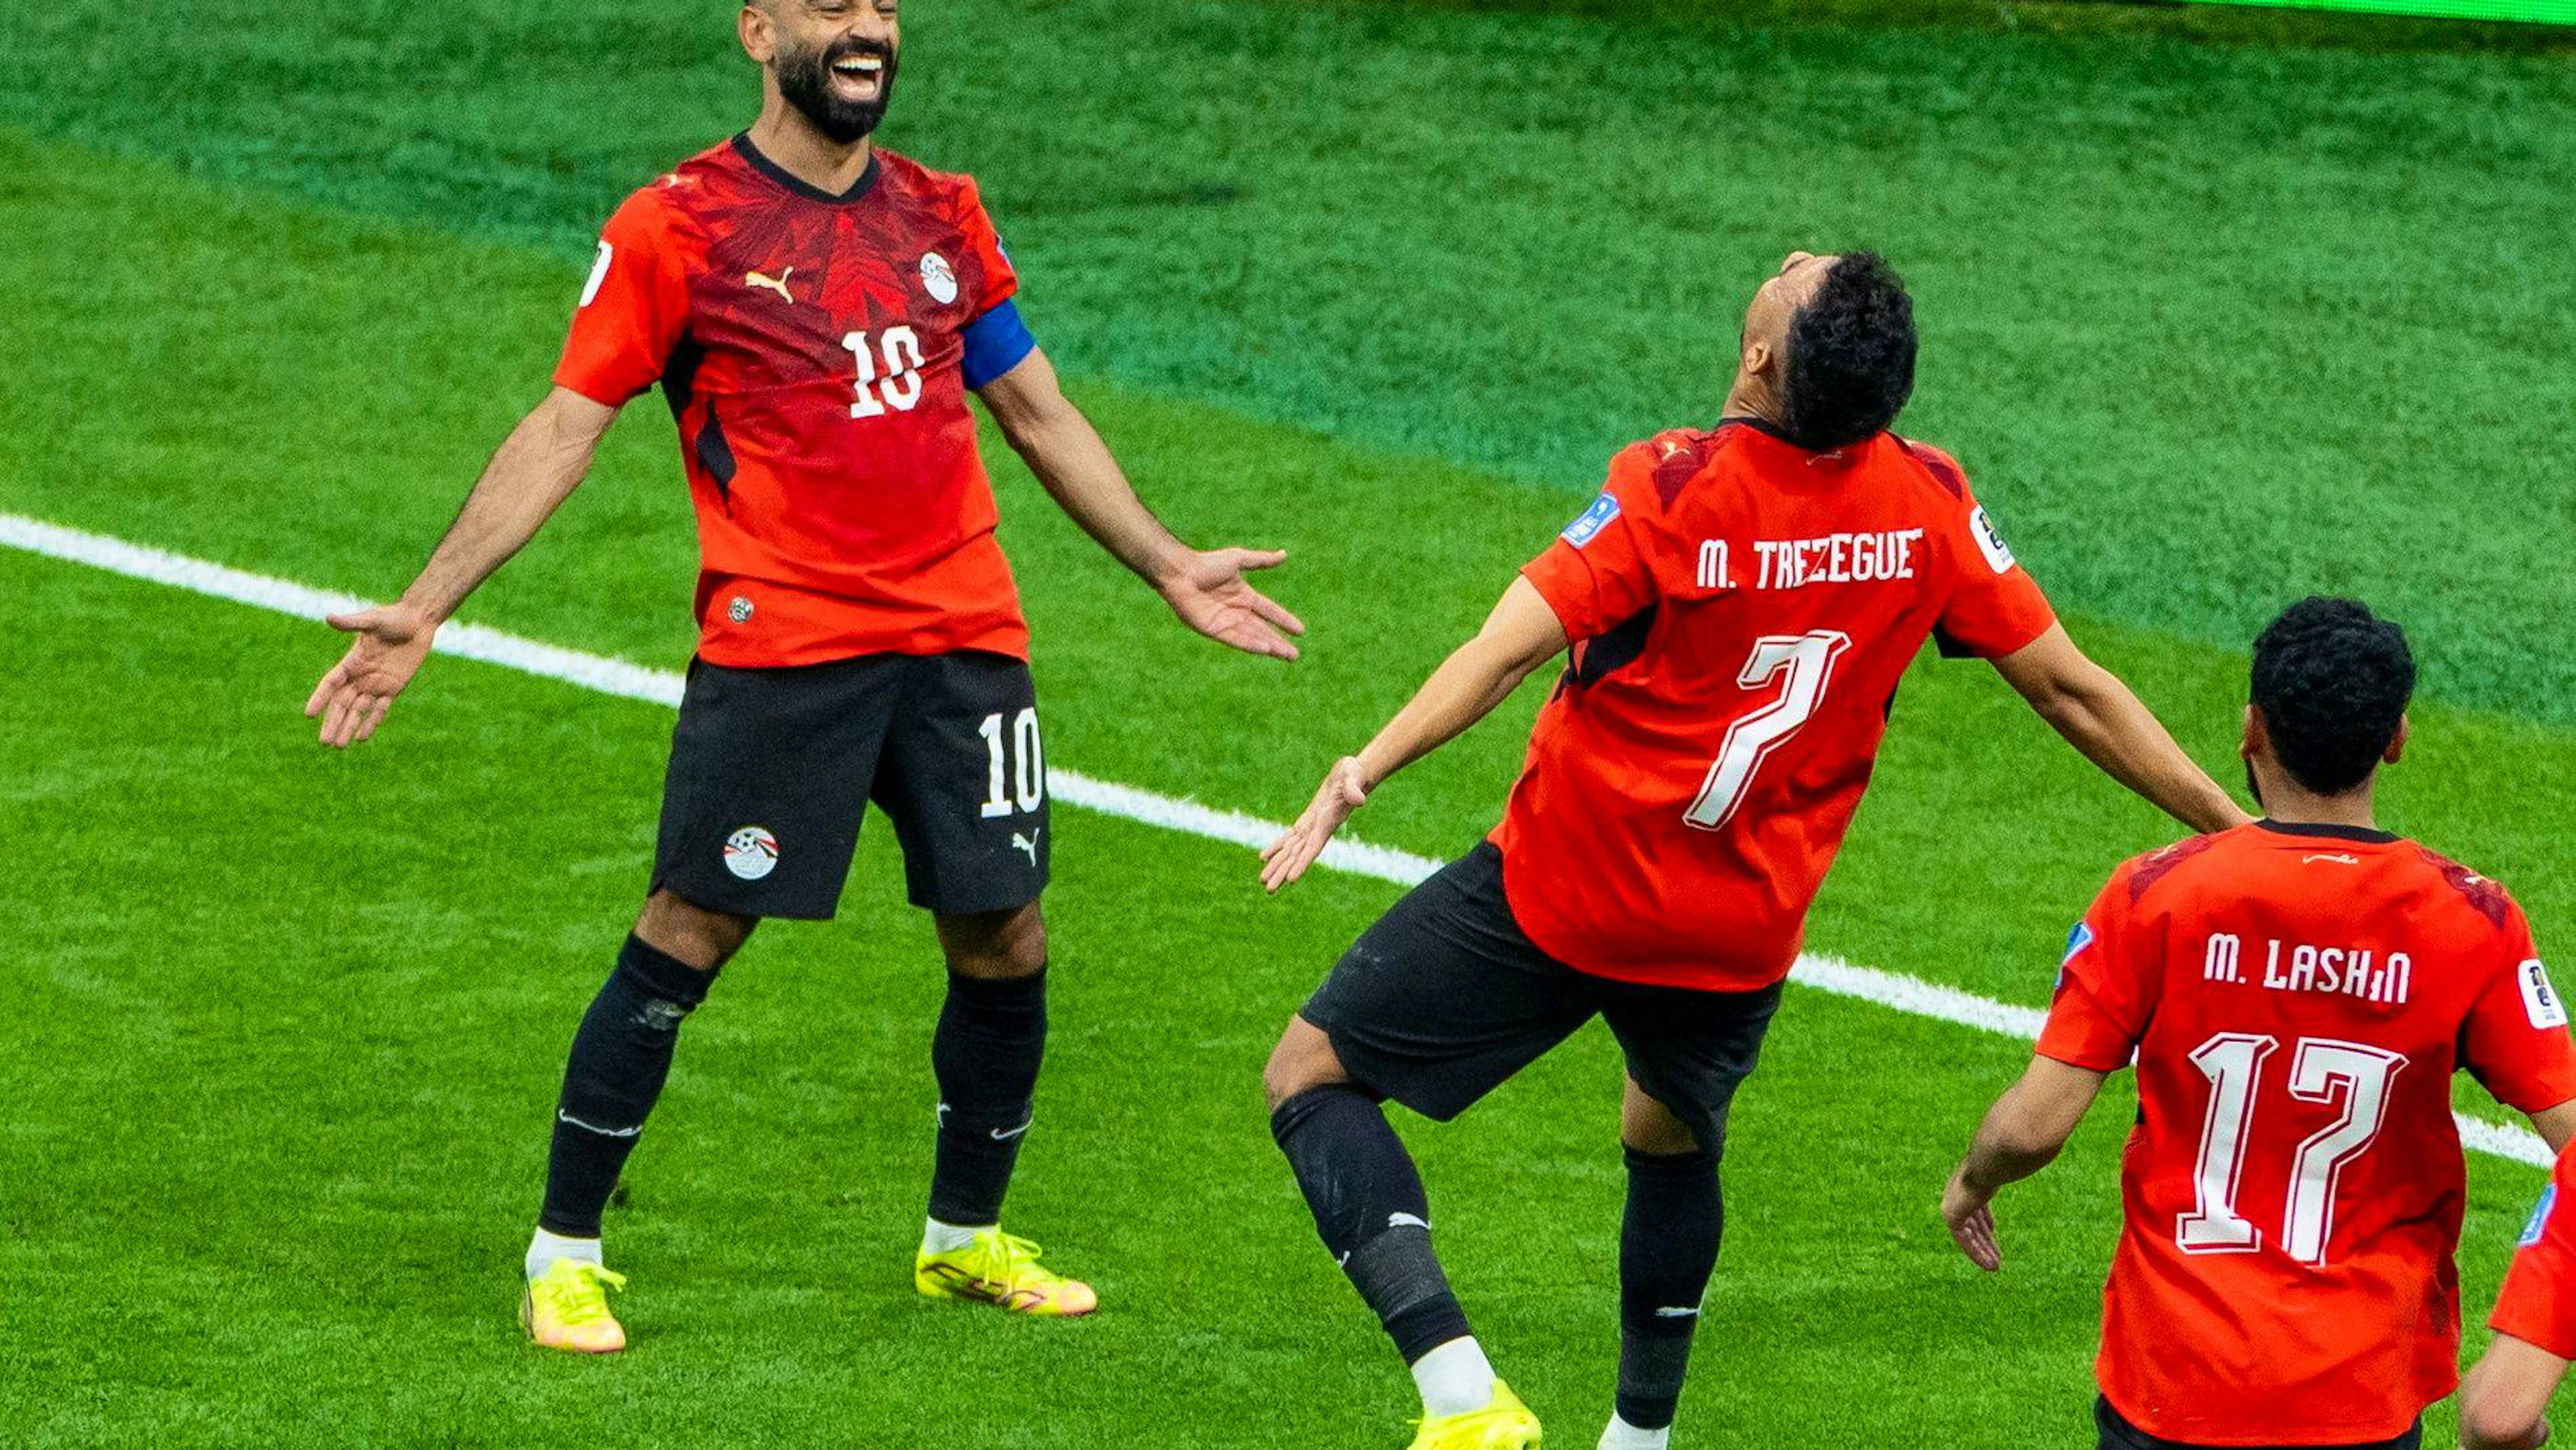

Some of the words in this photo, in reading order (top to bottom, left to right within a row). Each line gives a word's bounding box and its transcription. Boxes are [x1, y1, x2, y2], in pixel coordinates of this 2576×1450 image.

[841, 325, 926, 419] 10
[1697, 539, 1736, 588] M.
[1754, 527, 1923, 590] TREZEGUE
[978, 707, 1042, 818] 10
[1682, 629, 1851, 831] 7
[2204, 933, 2247, 984] M.
[2175, 1031, 2410, 1267] 17
